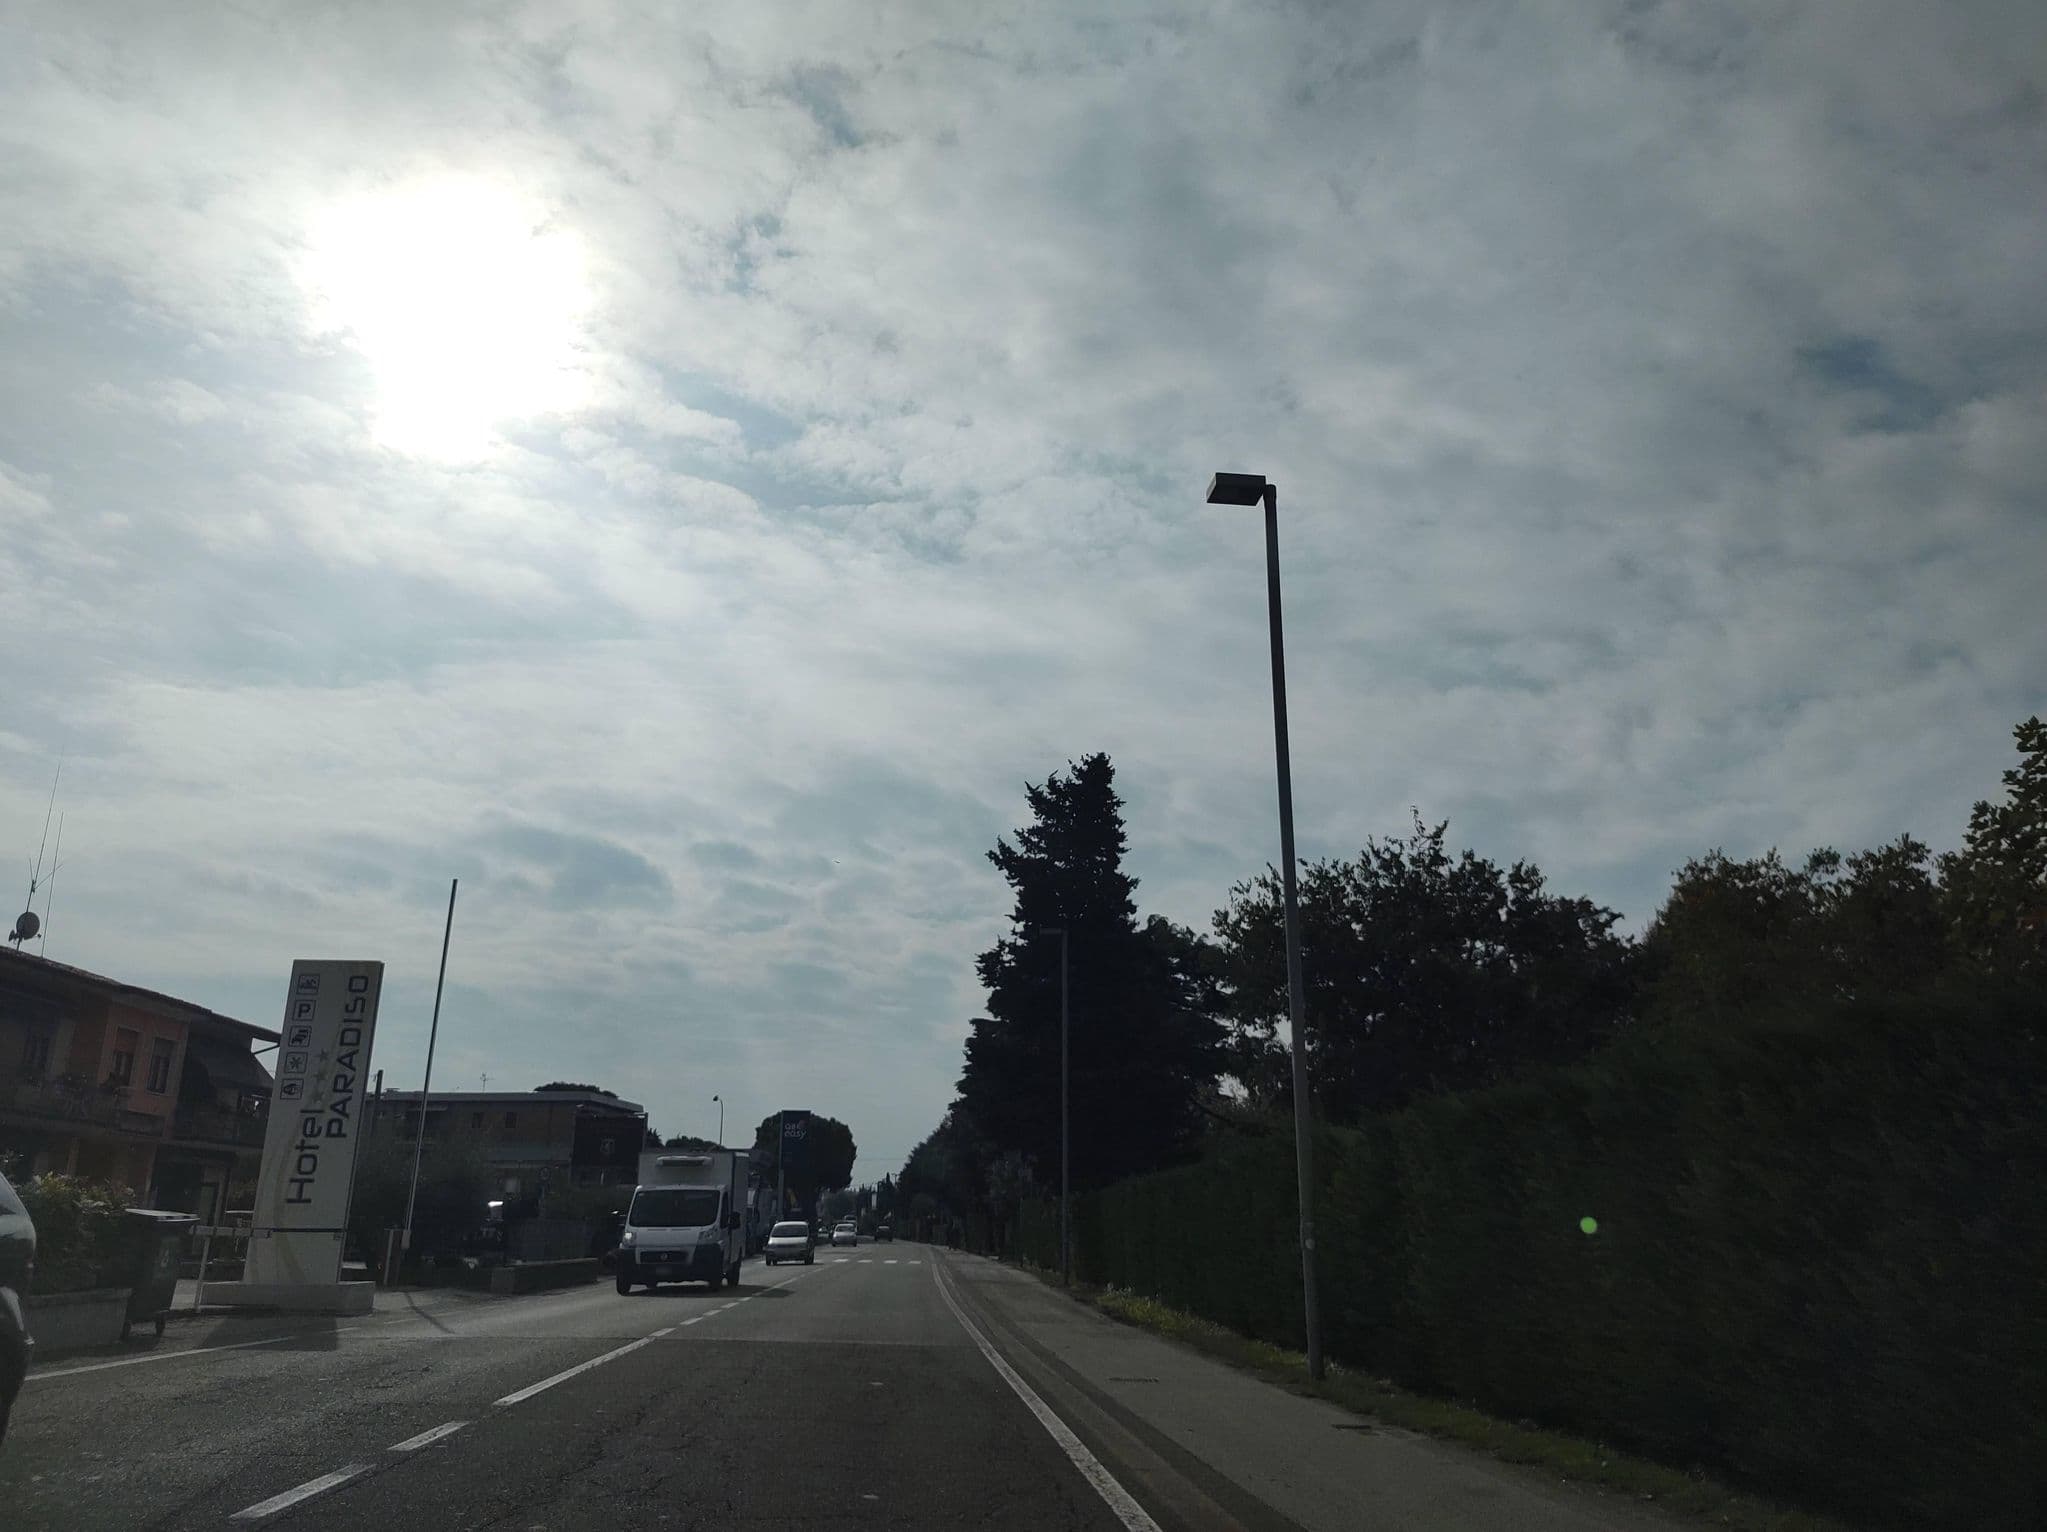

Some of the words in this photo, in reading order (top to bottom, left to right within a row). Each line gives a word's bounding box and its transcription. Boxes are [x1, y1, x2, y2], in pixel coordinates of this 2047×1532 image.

[298, 1003, 311, 1017] P
[326, 975, 368, 1138] PARADISO
[286, 1110, 325, 1203] Hotel
